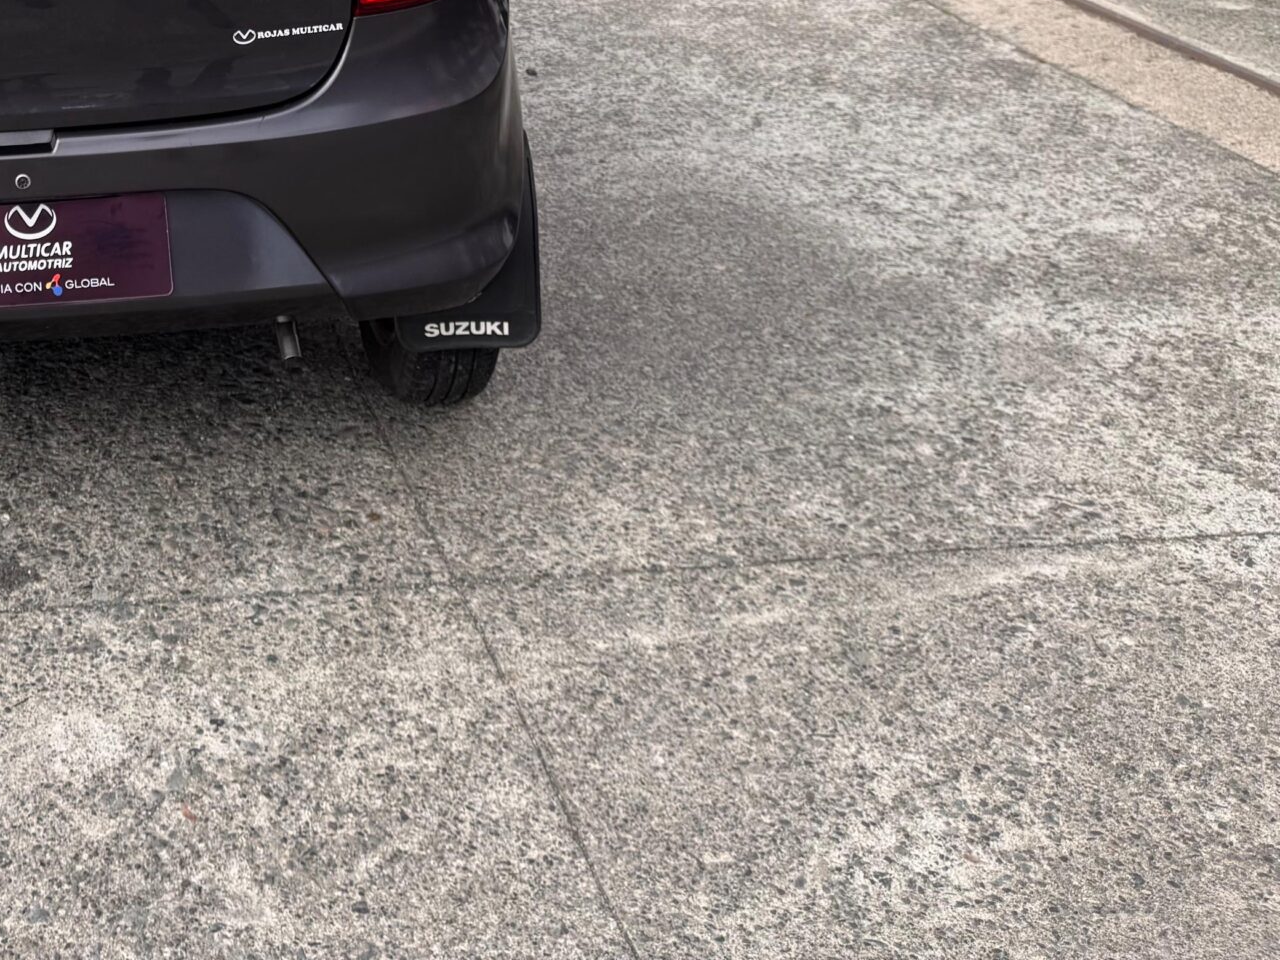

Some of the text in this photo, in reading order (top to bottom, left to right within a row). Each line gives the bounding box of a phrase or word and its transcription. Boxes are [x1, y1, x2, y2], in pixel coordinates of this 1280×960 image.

[257, 23, 344, 40] ROJAS MULTICAR
[14, 281, 43, 294] CON
[64, 275, 116, 291] GLOBAL
[424, 320, 511, 338] SUZUKI
